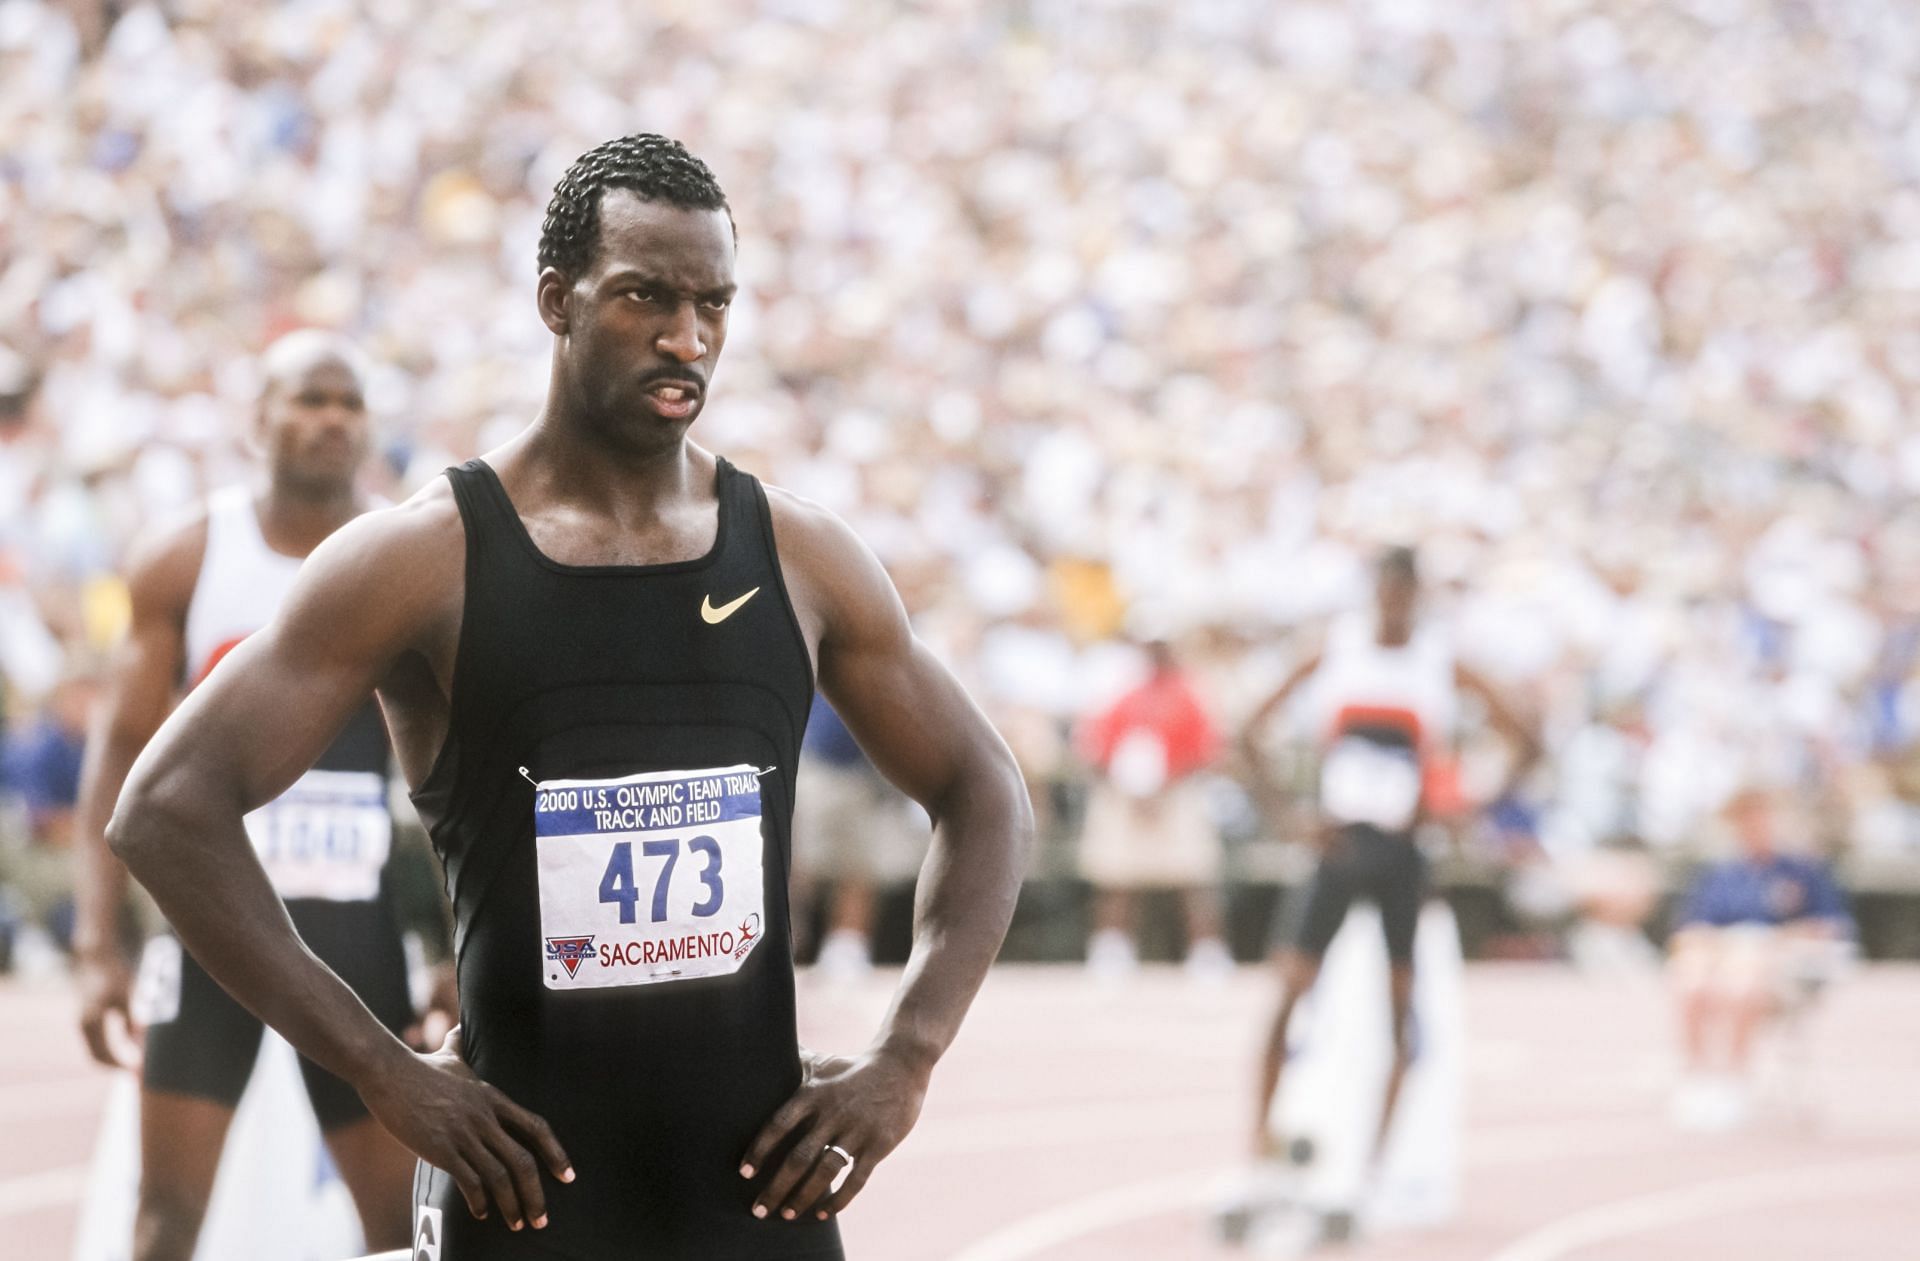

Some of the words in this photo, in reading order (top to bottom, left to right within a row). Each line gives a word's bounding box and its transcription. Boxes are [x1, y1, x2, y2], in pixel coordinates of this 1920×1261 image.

[539, 791, 578, 812] 2000
[583, 789, 612, 809] U.S.
[617, 783, 684, 807] OLYMPIC
[687, 778, 722, 801] TEAM
[724, 774, 760, 796] TRIALS
[594, 808, 645, 830] TRACK
[649, 805, 682, 827] AND
[686, 800, 720, 823] FIELD
[598, 835, 724, 924] 473
[546, 942, 597, 954] USA
[600, 931, 734, 967] SACRAMENTO
